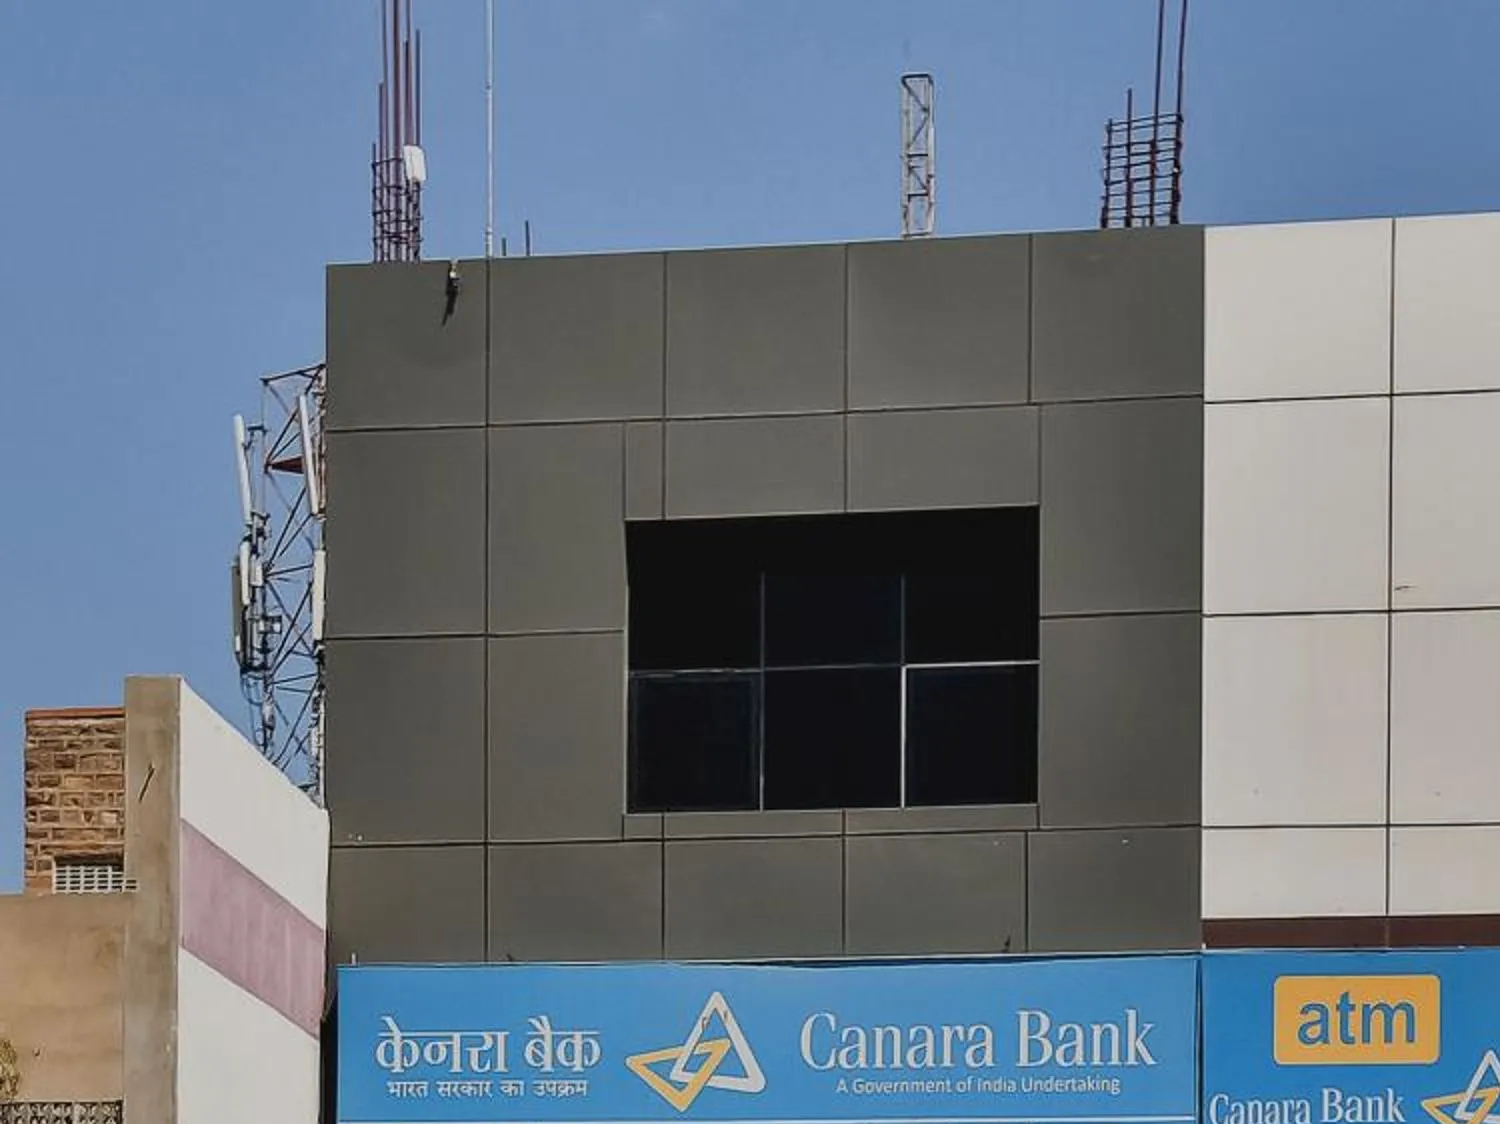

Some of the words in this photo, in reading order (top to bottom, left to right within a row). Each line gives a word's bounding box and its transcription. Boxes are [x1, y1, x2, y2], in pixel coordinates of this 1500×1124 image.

[800, 1012, 997, 1070] Canara
[1015, 1008, 1159, 1067] Bank
[1297, 991, 1416, 1045] atm
[375, 1015, 509, 1073] केनरा
[387, 1079, 429, 1098] भारत
[435, 1079, 493, 1098] सरकार
[499, 1078, 525, 1097] का
[836, 1079, 849, 1094] A
[852, 1077, 953, 1095] Government
[956, 1075, 974, 1093] of
[977, 1077, 1017, 1093] India
[1021, 1074, 1121, 1095] Undertaking
[1319, 1087, 1407, 1124] Bank
